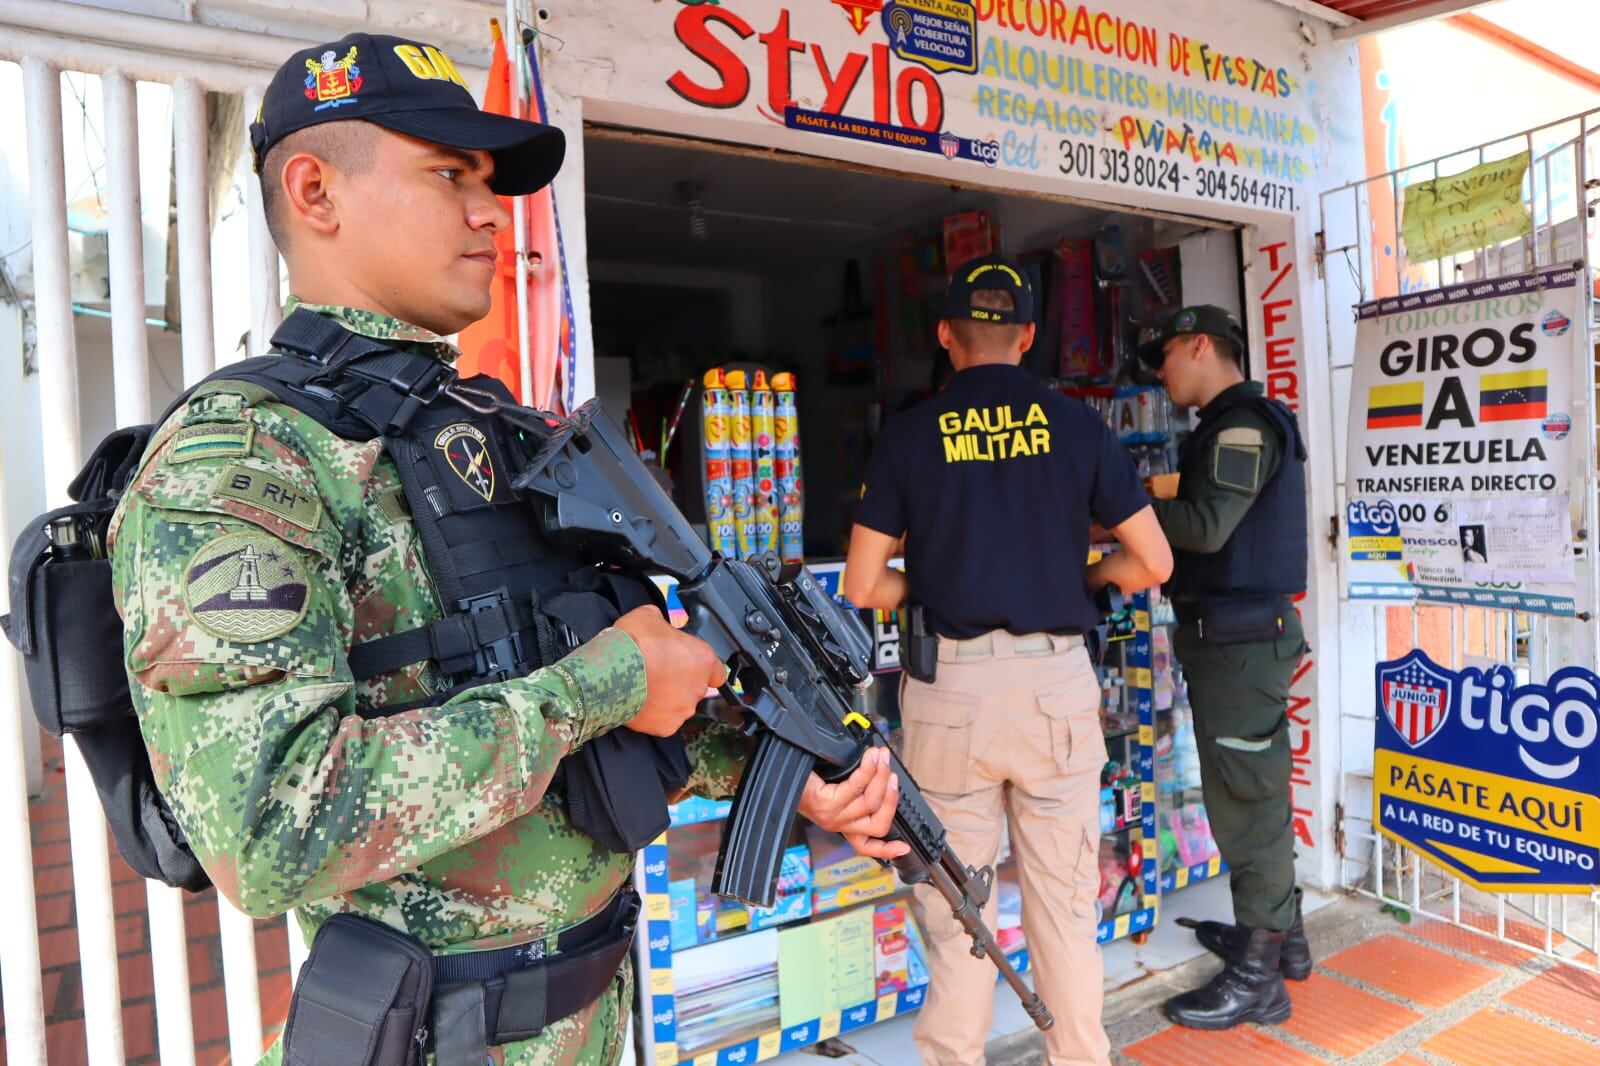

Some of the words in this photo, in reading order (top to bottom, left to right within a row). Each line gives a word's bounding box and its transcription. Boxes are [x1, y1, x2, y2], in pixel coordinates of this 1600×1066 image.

[913, 14, 943, 28] MEJOR
[943, 20, 971, 35] SEÑAL
[913, 26, 968, 47] COBERTURA
[913, 39, 966, 58] VELOCIDAD
[976, 0, 1157, 67] DECORACION
[1169, 32, 1191, 77] DE
[1199, 44, 1292, 98] FIESTAS
[665, 3, 944, 134] Stylo
[979, 35, 1150, 110] ALQUILERES
[1166, 82, 1307, 147] MISCELANEA
[795, 114, 829, 129] PÁSATE
[831, 120, 838, 129] A
[839, 121, 850, 132] LA
[852, 124, 868, 135] RED
[869, 128, 881, 138] DE
[882, 130, 895, 142] TU
[895, 134, 928, 146] EQUIPO
[977, 85, 1098, 138] REGALOS
[1059, 139, 1094, 178] 301
[1259, 242, 1299, 409] T/FER
[1382, 293, 1543, 336] TODOGIROS
[1380, 323, 1537, 377] GIROS
[938, 403, 1049, 435] GAULA
[1425, 376, 1476, 430] A
[942, 428, 1050, 463] MILITAR
[1366, 437, 1547, 467] VENEZUELA
[231, 474, 252, 490] B
[1356, 476, 1464, 493] TRANSFIERA
[1471, 474, 1557, 492] DIRECTO
[1392, 689, 1437, 705] JUNIOR
[1390, 764, 1491, 809] PÁSATE
[1499, 792, 1583, 832] AQUÍ
[1384, 804, 1396, 819] A
[1400, 807, 1419, 823] LA
[1422, 813, 1454, 834] RED
[1459, 822, 1481, 843] DE
[1485, 829, 1510, 849] TU
[1516, 837, 1595, 871] EQUIPO
